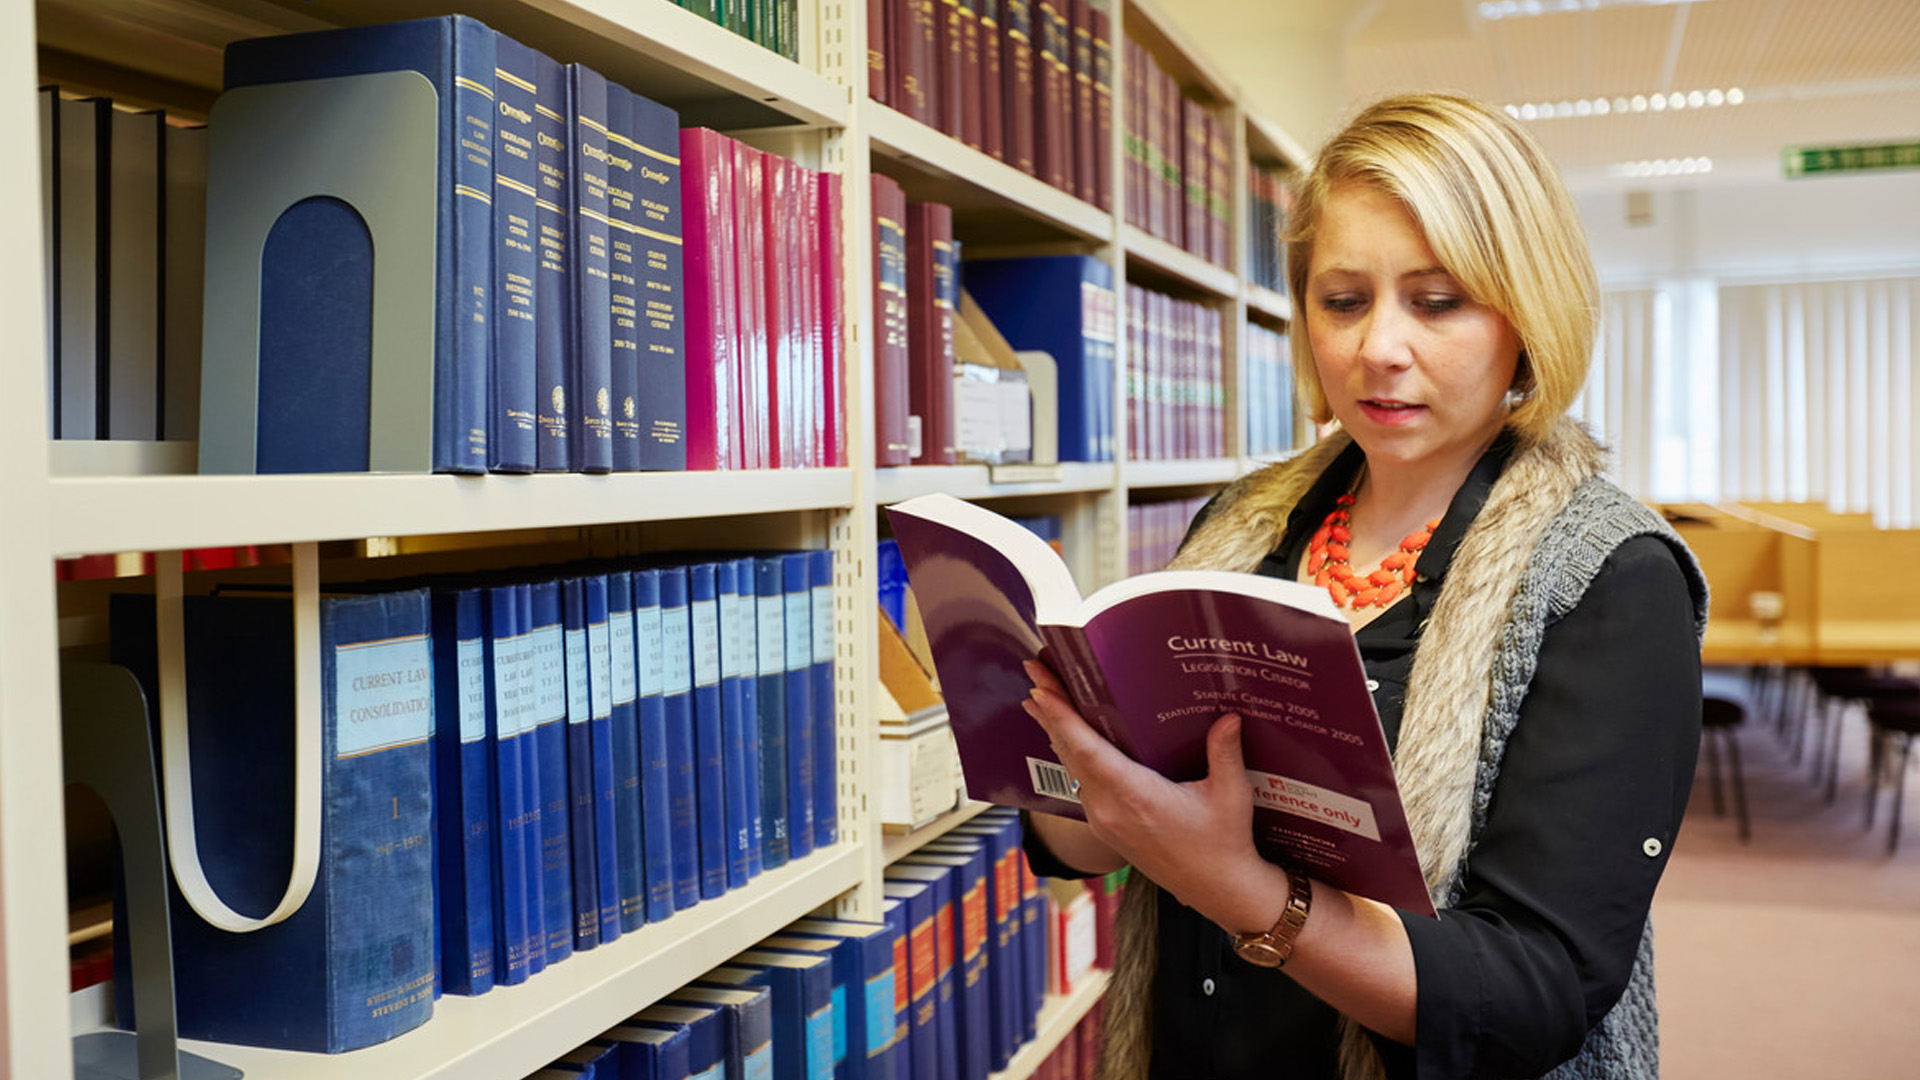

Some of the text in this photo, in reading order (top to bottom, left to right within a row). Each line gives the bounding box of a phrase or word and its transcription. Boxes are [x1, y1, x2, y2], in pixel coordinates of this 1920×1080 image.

[1167, 635, 1308, 668] Current Law
[352, 669, 403, 692] CURRENT
[350, 697, 429, 724] CONSOLIDATIO
[1287, 702, 1320, 720] 2005
[1331, 728, 1365, 747] 2005
[391, 796, 399, 819] 1
[1254, 787, 1318, 812] ference
[1323, 806, 1361, 828] only
